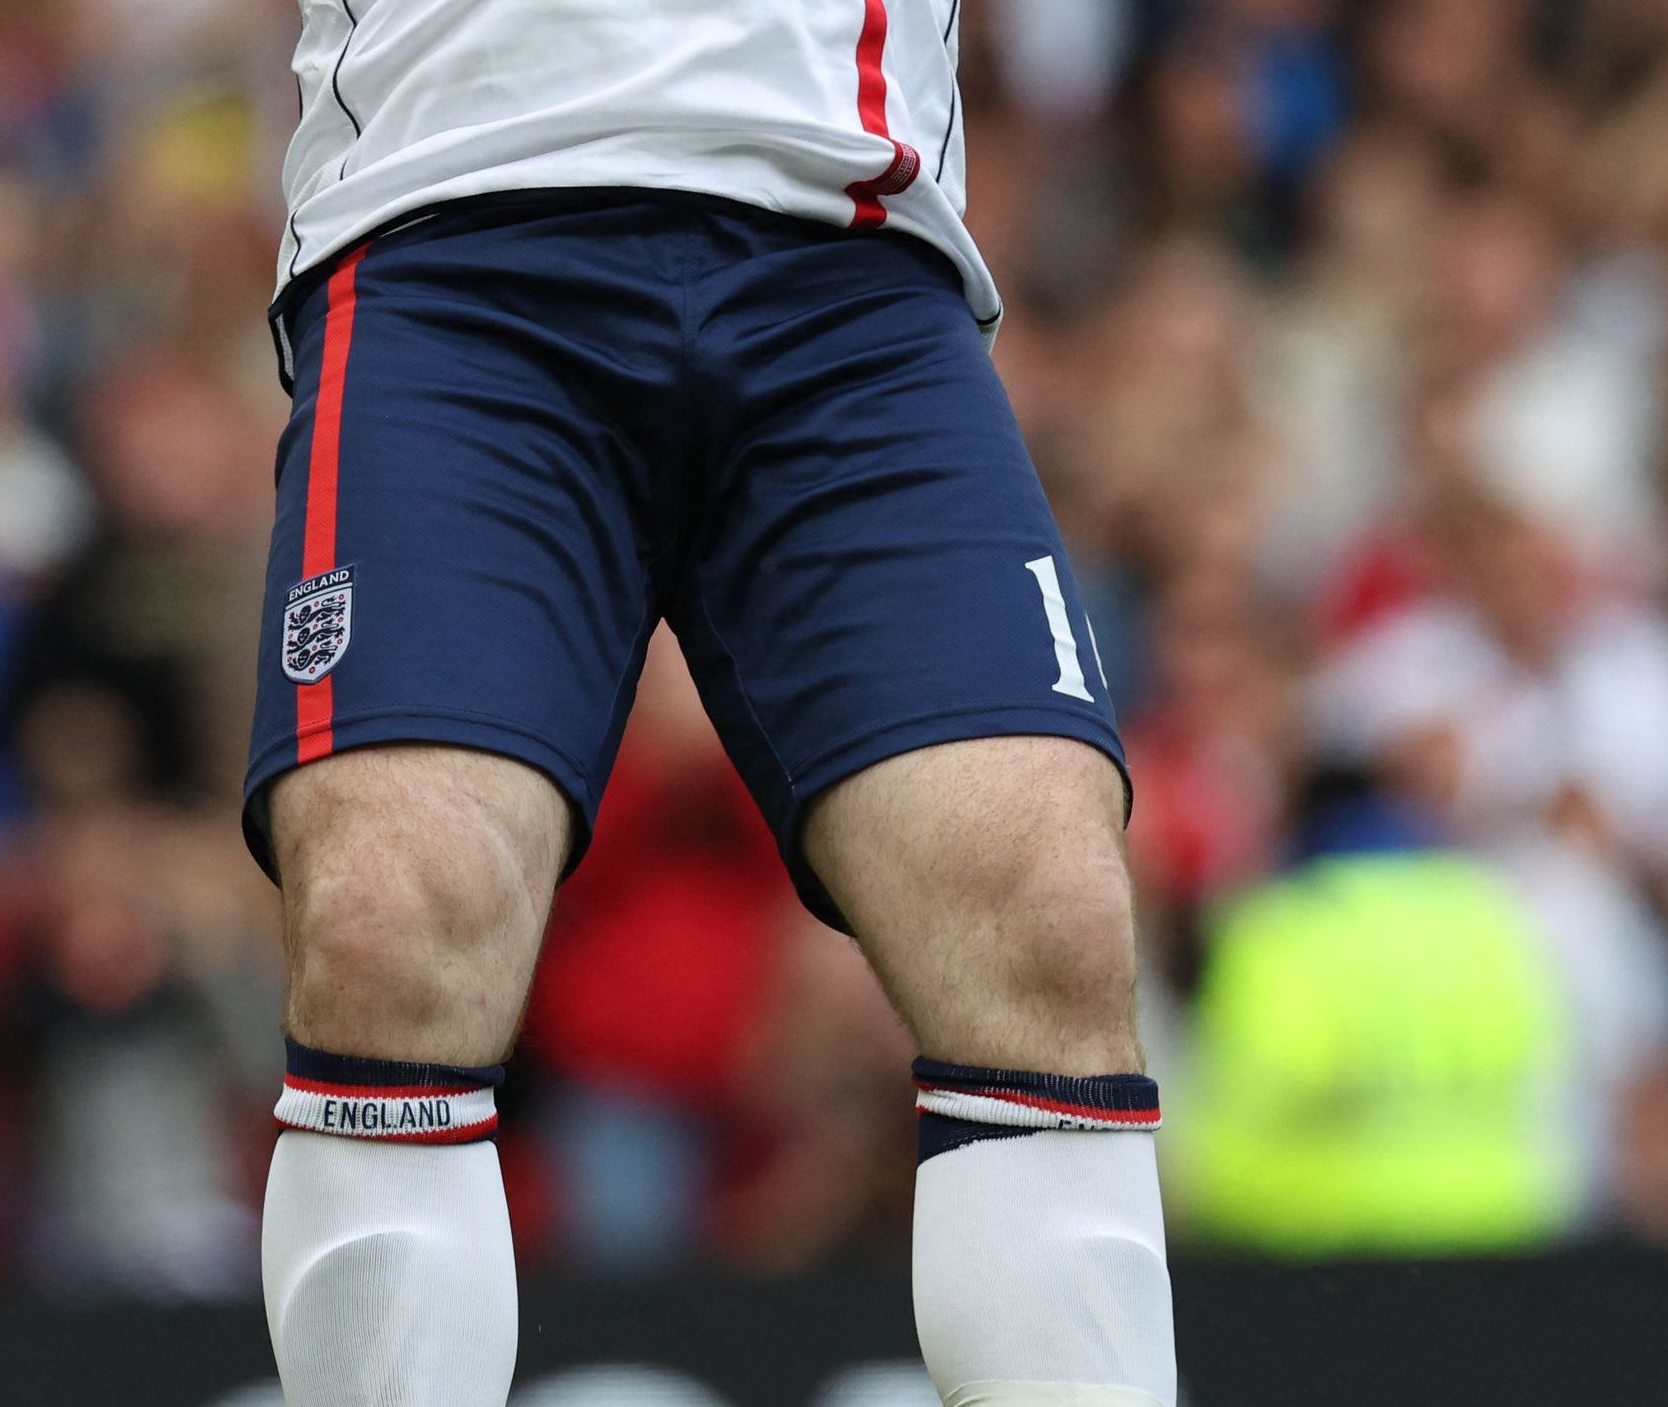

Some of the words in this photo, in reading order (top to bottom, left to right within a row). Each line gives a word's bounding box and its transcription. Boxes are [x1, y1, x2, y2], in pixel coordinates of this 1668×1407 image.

[288, 570, 350, 602] ENGLAND
[1024, 555, 1108, 703] 1
[323, 1099, 451, 1130] ENGLAND
